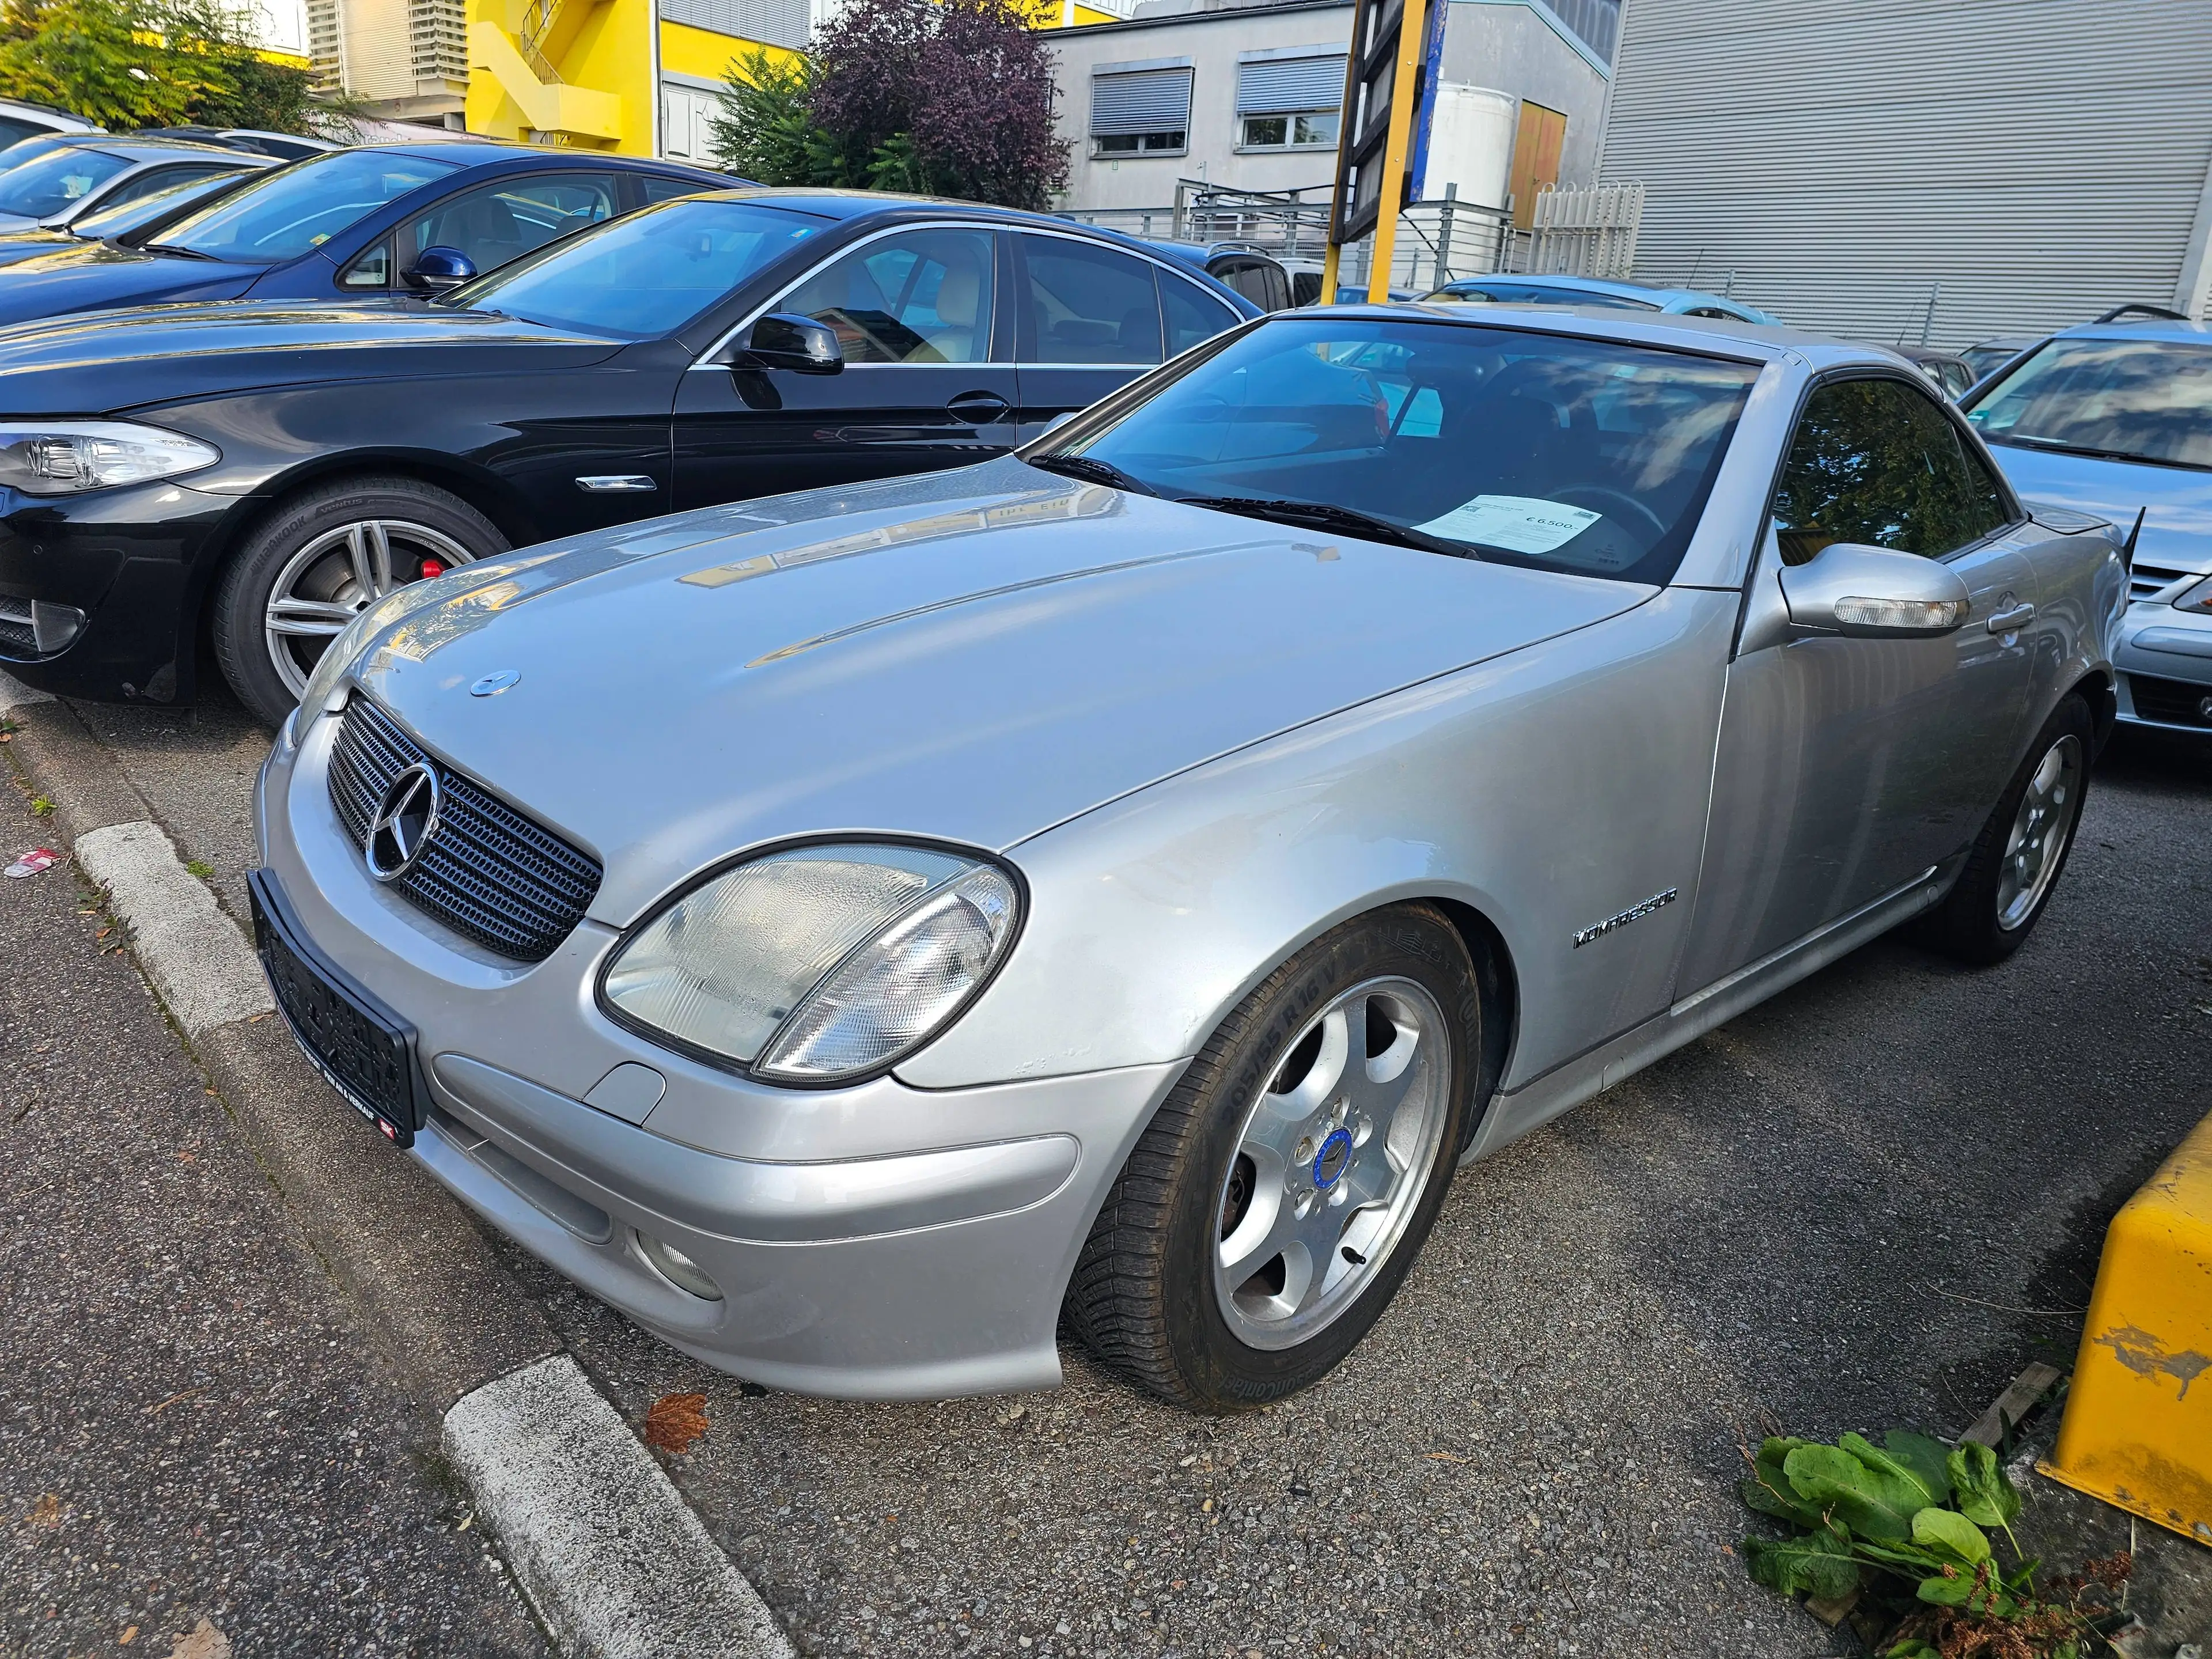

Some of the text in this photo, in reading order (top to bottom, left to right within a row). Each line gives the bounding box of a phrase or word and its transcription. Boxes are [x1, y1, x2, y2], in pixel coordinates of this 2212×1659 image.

[1572, 887, 1677, 949] KOMPRESSOR
[1221, 961, 1338, 1126] 205/55 R 16 V
[348, 1092, 375, 1120] VERKAUF
